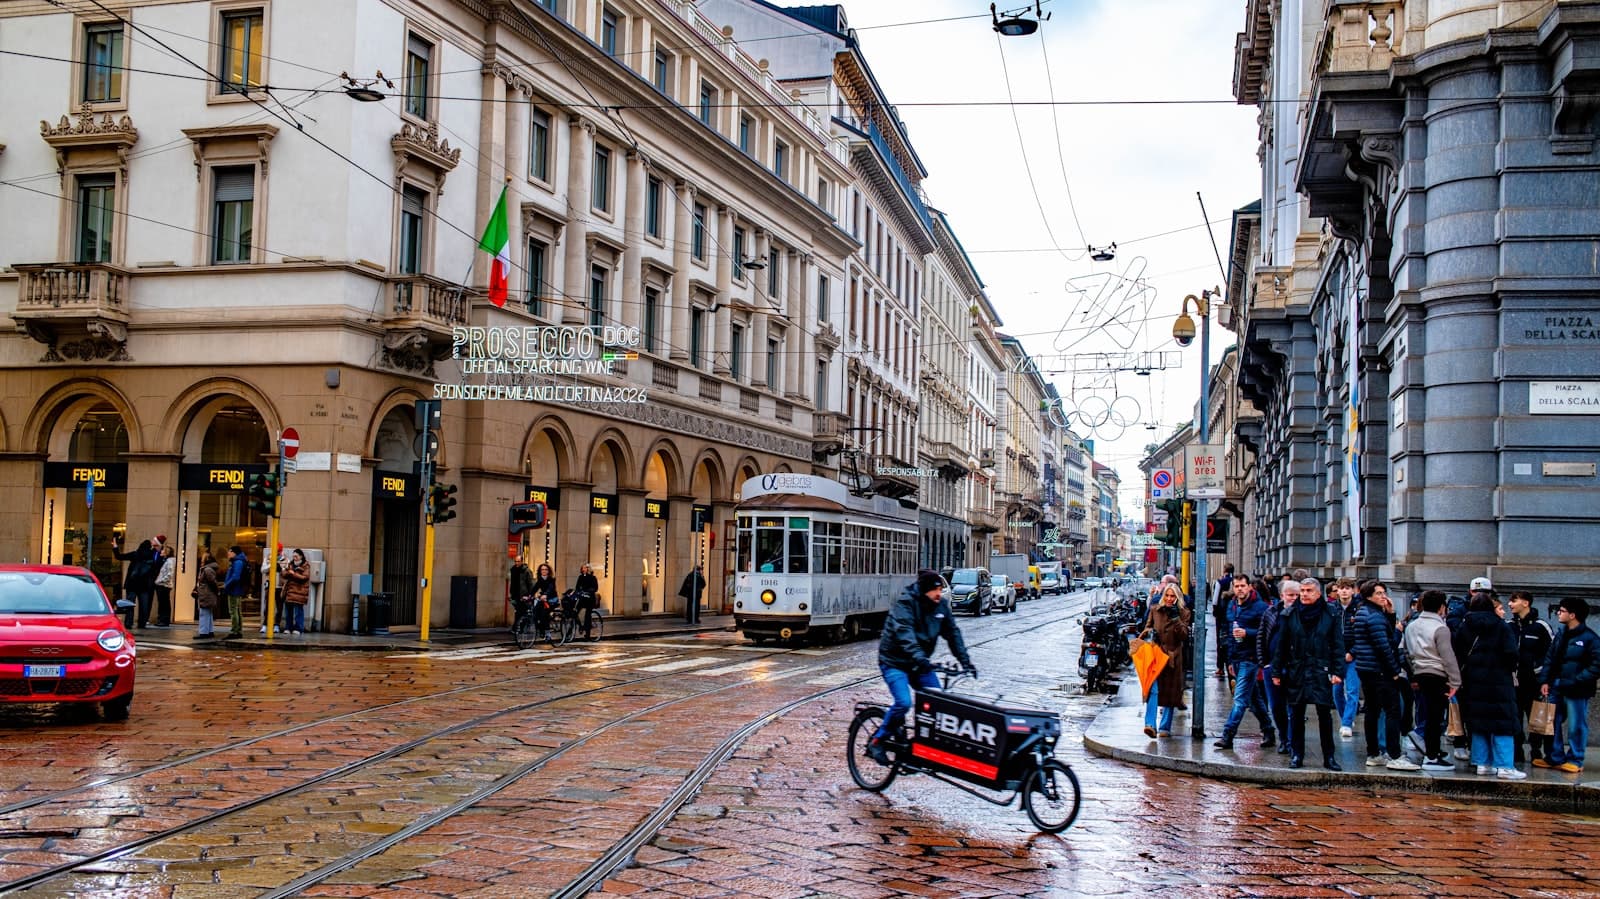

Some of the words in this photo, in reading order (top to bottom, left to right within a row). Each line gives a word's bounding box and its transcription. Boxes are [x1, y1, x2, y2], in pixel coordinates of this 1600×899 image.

[1545, 317, 1592, 327] PIAZZA
[1525, 330, 1566, 339] DELLA
[452, 326, 594, 359] PROSECCO
[603, 326, 640, 346] DOC
[463, 360, 512, 375] OFFICIAL
[513, 359, 582, 375] SPARKLING
[585, 360, 614, 375] WINE
[433, 384, 487, 400] SPONSOR
[504, 385, 554, 401] MILANO
[555, 386, 613, 402] CORTINA
[613, 387, 647, 403] 2026
[1567, 397, 1600, 405] SCALA
[1194, 456, 1216, 465] Wi-Fi
[73, 468, 106, 482] FENDI
[210, 469, 245, 483] FENDI
[1194, 466, 1216, 475] area
[382, 477, 405, 491] FENDI
[940, 713, 998, 746] BAR
